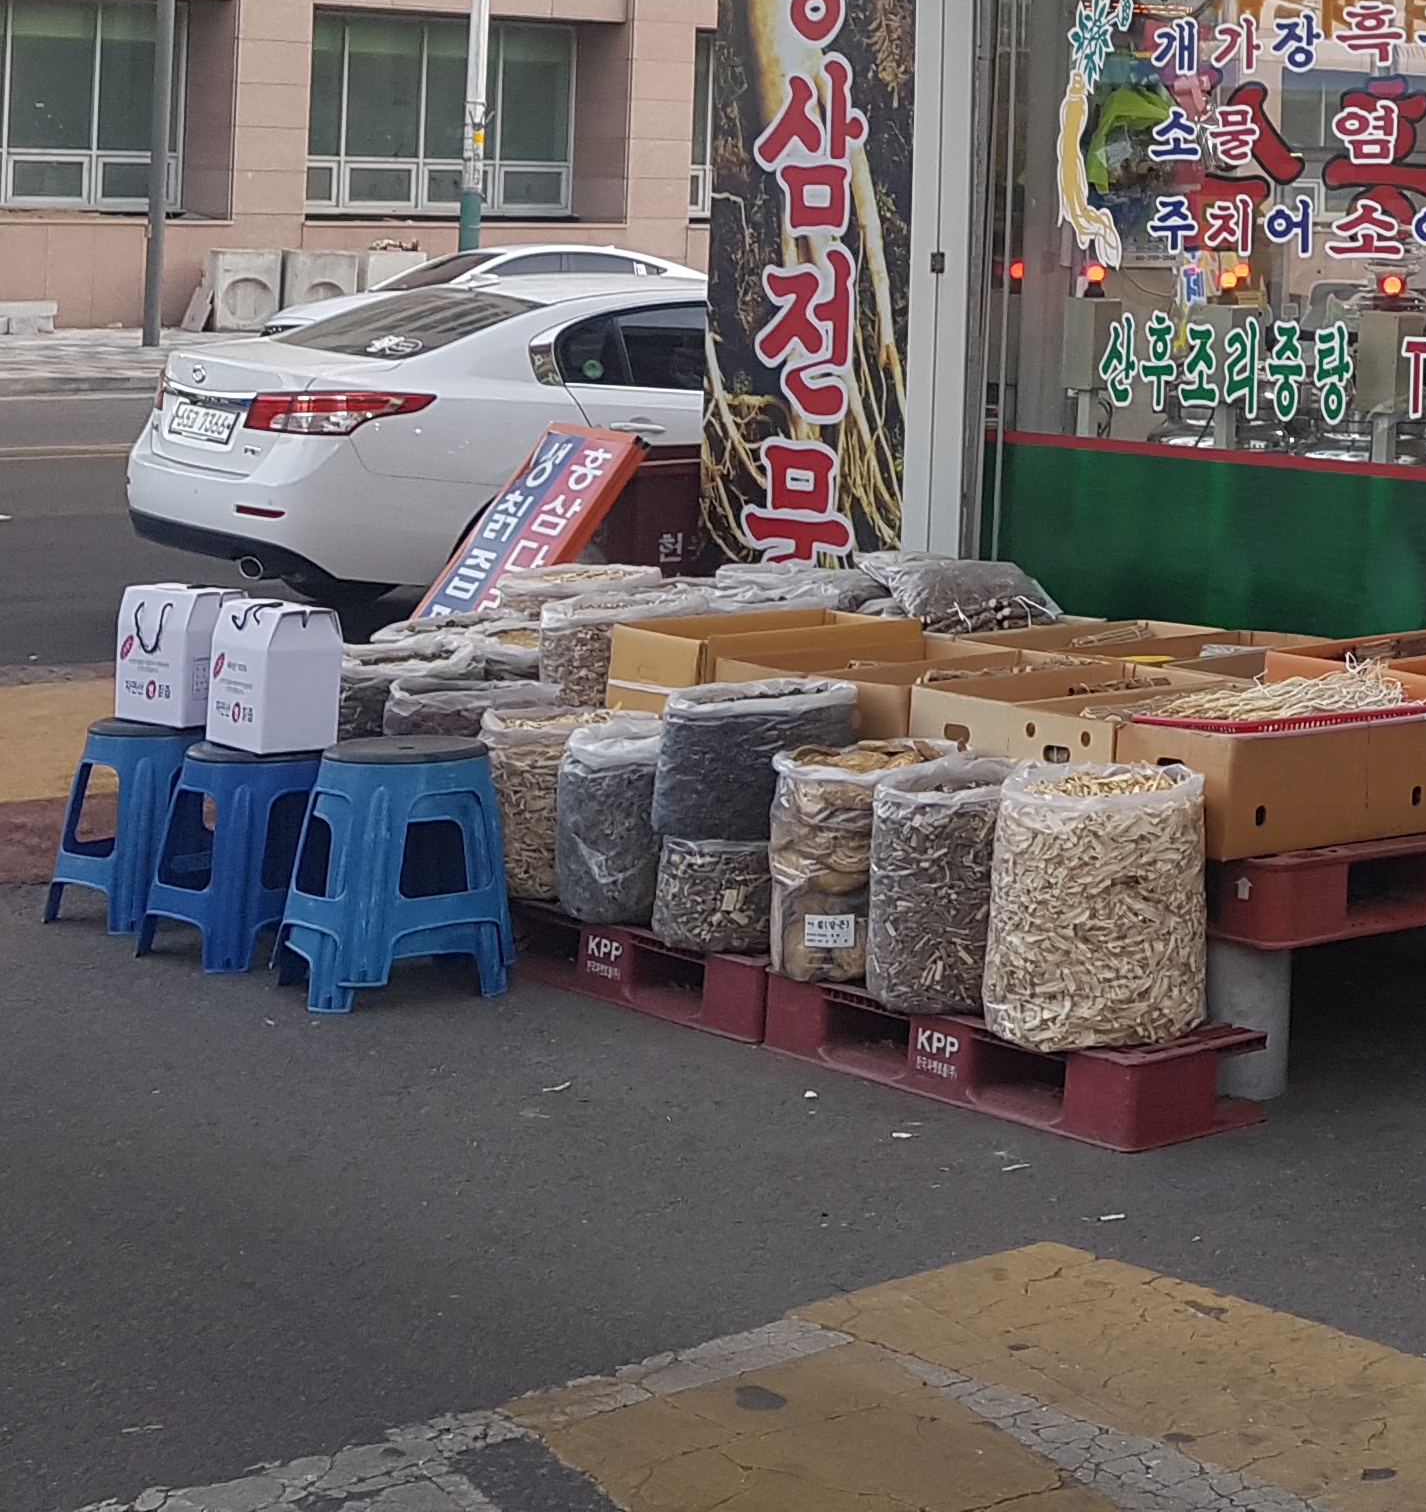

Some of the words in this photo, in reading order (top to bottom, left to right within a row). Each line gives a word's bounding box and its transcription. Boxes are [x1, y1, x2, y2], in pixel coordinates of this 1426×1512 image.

[1099, 311, 1353, 425] 산후조리중탕
[587, 934, 623, 962] KPP
[917, 1027, 959, 1058] KPP
